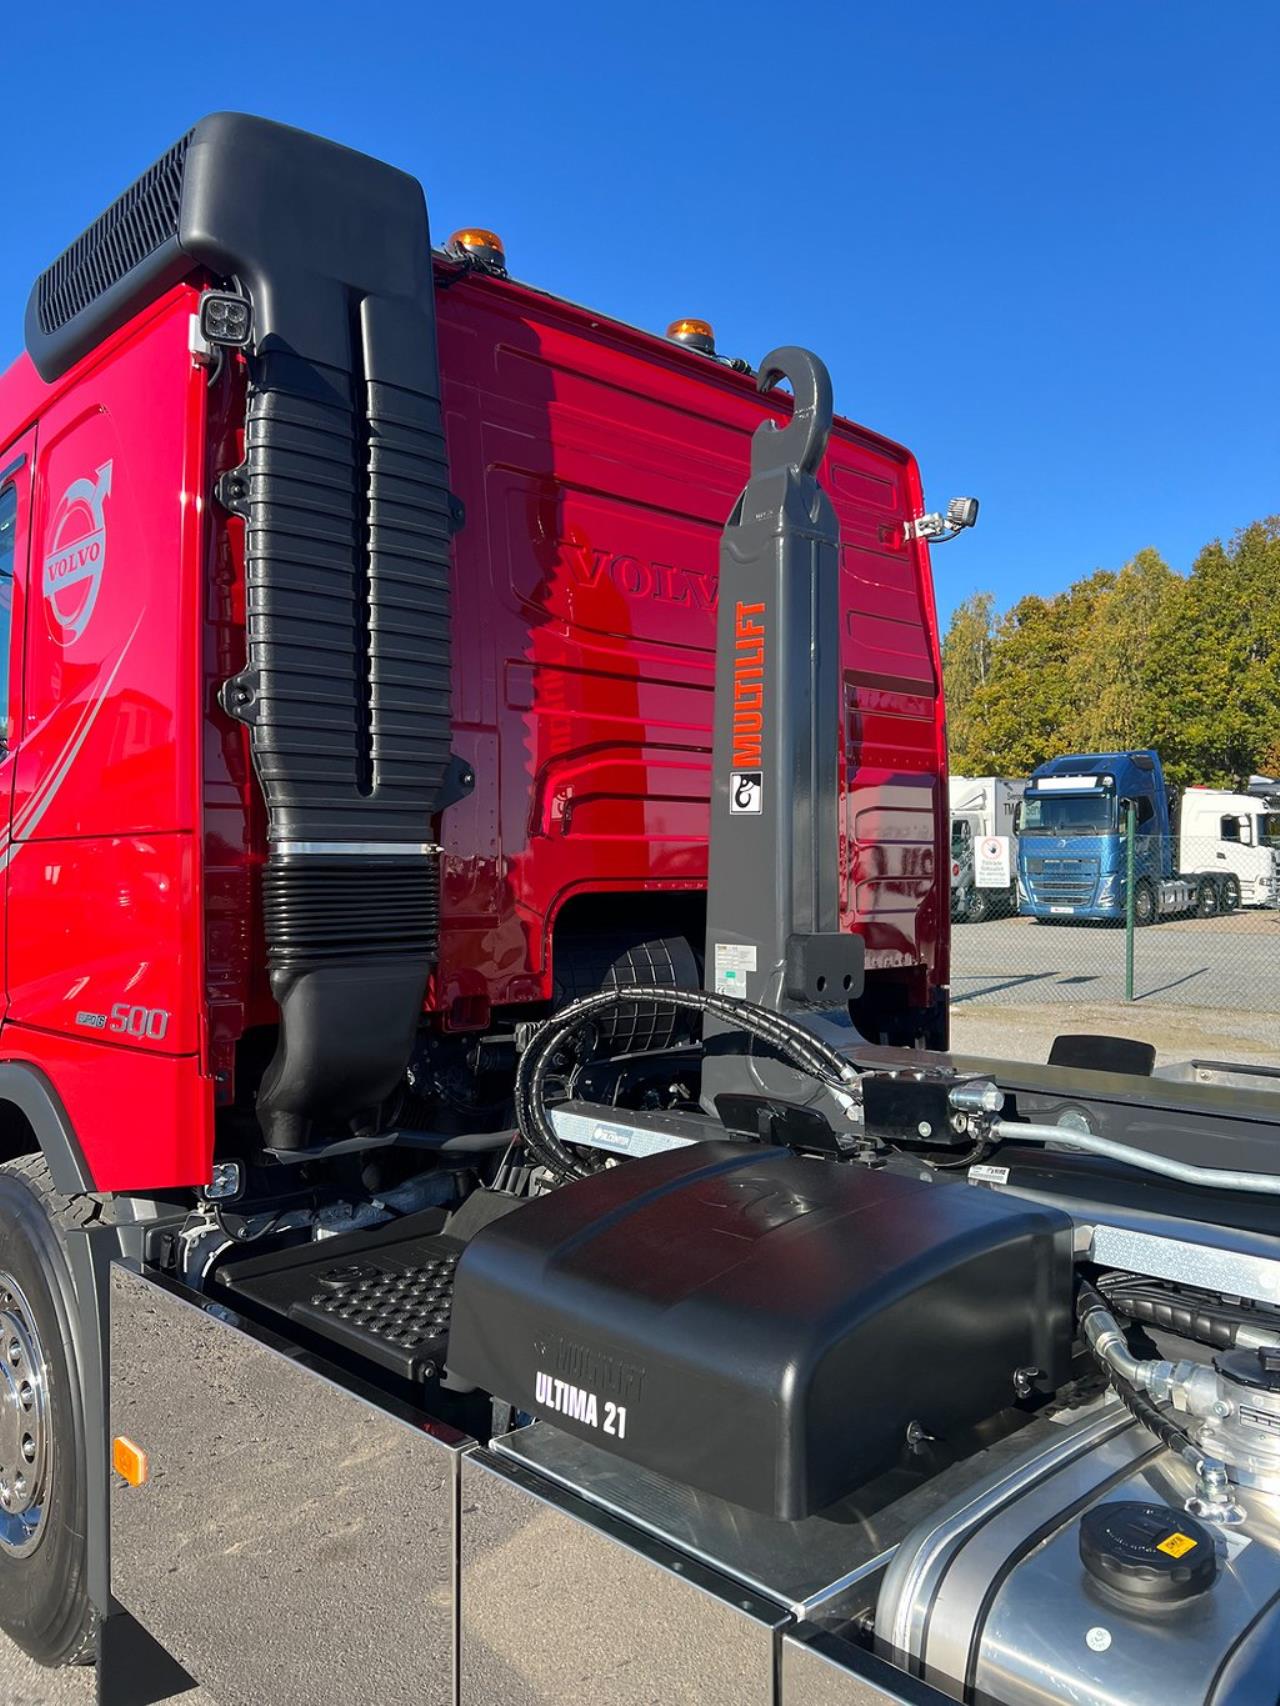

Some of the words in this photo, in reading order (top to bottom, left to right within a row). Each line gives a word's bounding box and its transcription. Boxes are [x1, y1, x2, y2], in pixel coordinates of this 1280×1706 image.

[48, 542, 100, 581] VOLVO
[557, 540, 719, 612] VOLV
[732, 601, 766, 768] MULTILIFT
[110, 1003, 168, 1040] 500
[535, 1371, 598, 1428] ULTIMA
[603, 1401, 627, 1439] 21
